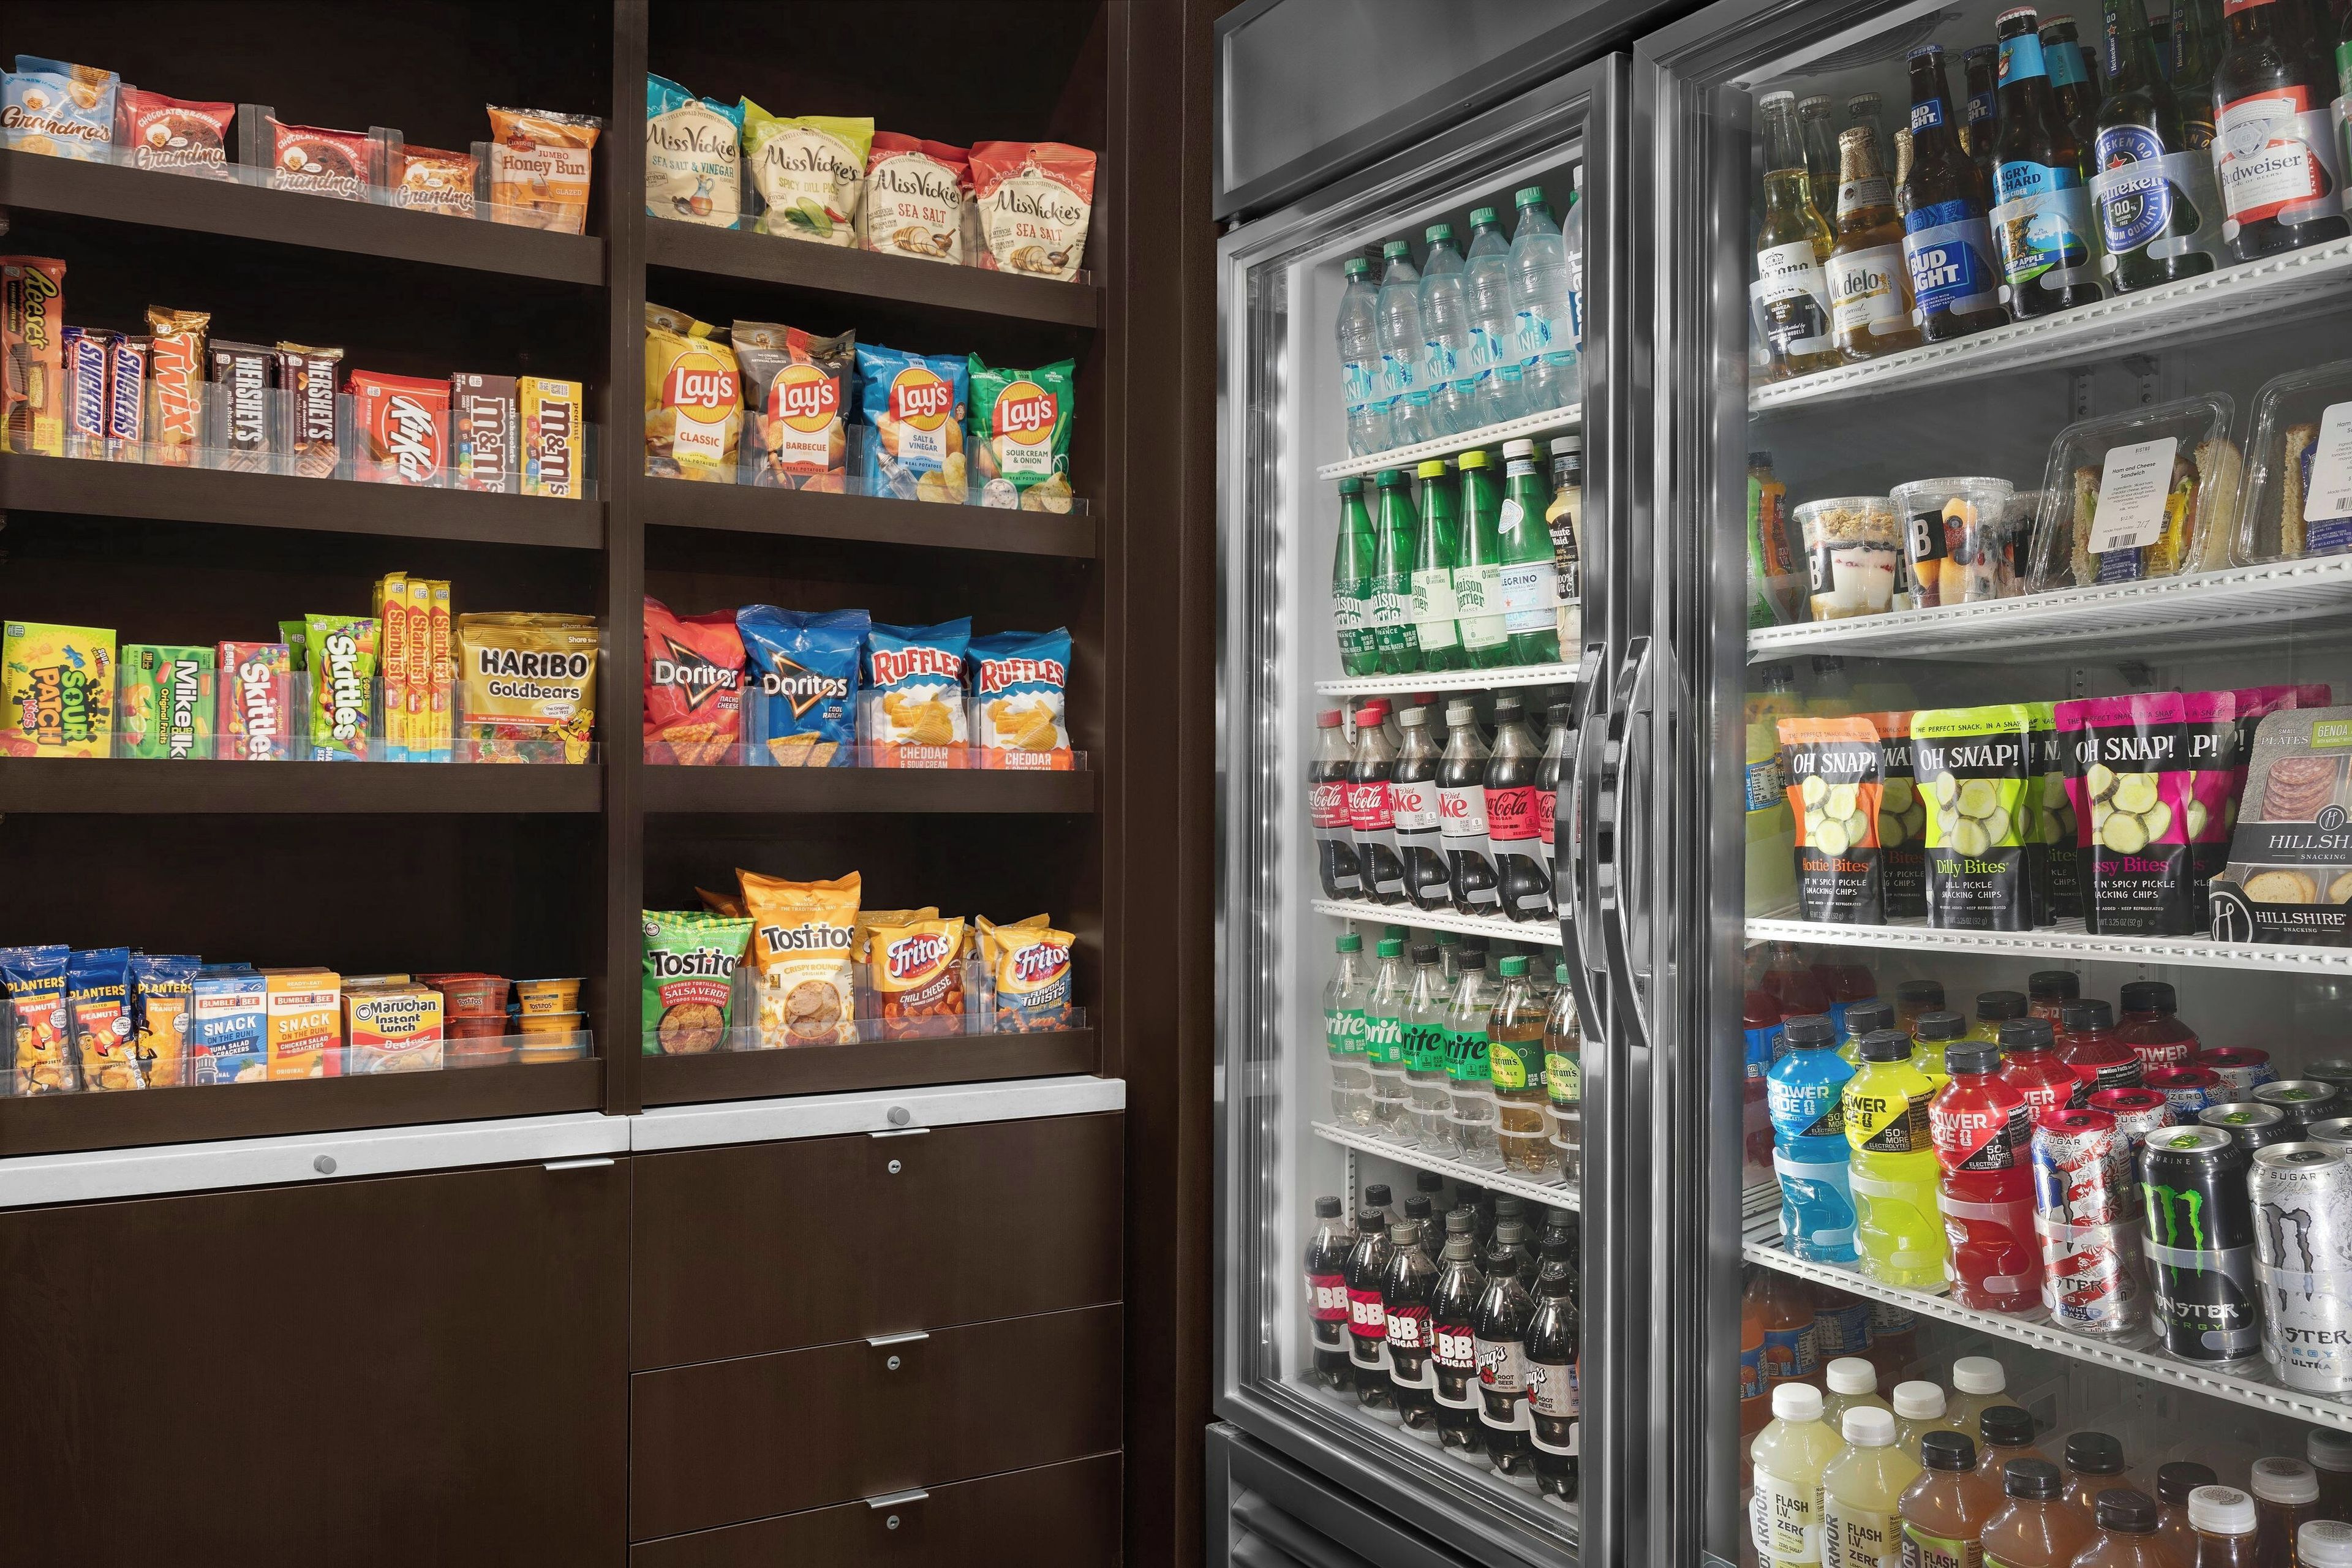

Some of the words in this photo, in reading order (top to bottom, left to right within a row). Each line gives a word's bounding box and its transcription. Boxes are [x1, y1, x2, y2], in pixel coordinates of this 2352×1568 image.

[1, 105, 111, 141] Grandma's
[538, 150, 568, 160] JUMBO
[503, 155, 551, 176] Honey
[556, 159, 585, 176] Bun
[652, 155, 668, 168] SEA
[670, 160, 688, 171] SALT
[692, 163, 699, 173] &
[701, 162, 734, 178] VINEGAR
[766, 144, 807, 173] Miss
[801, 145, 859, 186] Vickie's
[2222, 154, 2301, 187] Budweiser
[556, 187, 582, 196] GLAZED
[2010, 188, 2027, 197] CIDER
[898, 203, 918, 219] SEA
[923, 207, 946, 223] SALT
[994, 190, 1031, 214] Miss
[1027, 193, 1080, 225] Vickie's
[2116, 214, 2132, 222] ALCOHOL
[1017, 223, 1036, 239] SEA
[1041, 227, 1062, 241] SALT
[1911, 250, 1947, 274] BUD
[2019, 253, 2045, 265] APPLE
[23, 265, 59, 350] Reese's
[78, 341, 103, 434] SNICKERS
[115, 350, 140, 441] SNICKERS
[674, 367, 733, 408] Lay's
[236, 357, 263, 442] HERSHEY'S
[308, 360, 334, 440] HERSHEY'S
[778, 378, 835, 418] Lay's
[898, 382, 948, 418] Lay's
[1003, 394, 1052, 432] Lay's
[680, 432, 720, 447] CLASSIC
[786, 441, 827, 452] BARBECUE
[909, 442, 938, 452] VINEGAR
[1006, 450, 1025, 458] SOUR
[2120, 470, 2145, 479] Sandwich
[1915, 519, 1932, 557] B
[1810, 555, 1822, 590] B
[388, 610, 405, 680] Starburst
[410, 615, 428, 685] Starburst
[481, 649, 588, 677] HARIBO
[874, 649, 961, 685] RUFFLES
[655, 660, 738, 688] Doritos
[981, 659, 1065, 692] RUFFLES
[175, 660, 198, 728] Mike
[326, 635, 363, 740] Skittles
[489, 681, 580, 699] Goldbears
[763, 673, 848, 697] Doritos
[23, 698, 37, 728] Kids
[34, 668, 62, 745] PATCH
[61, 670, 86, 741] SOUR
[159, 688, 170, 720] Original
[159, 721, 169, 746] Fruits
[1928, 724, 1955, 733] PERFECT
[1958, 723, 1982, 731] SNACK,
[2318, 725, 2348, 737] GENOA
[2075, 739, 2100, 764] OH
[2105, 735, 2174, 761] SNAP!
[2261, 736, 2309, 746] PLATES
[900, 747, 948, 760] CHEDDAR
[1005, 753, 1051, 766] CHEDDAR
[1793, 754, 1815, 774] OH
[1820, 752, 1877, 774] SNAP!
[1920, 748, 1945, 771] OH
[1949, 744, 2018, 767] SNAP!
[1831, 858, 1869, 872] Bites
[1936, 859, 1962, 877] Dilly
[1965, 860, 2006, 873] Bites
[2123, 856, 2169, 872] Bites
[1945, 881, 1959, 889] DILL
[1962, 881, 1992, 889] PICKLE
[2112, 880, 2138, 890] SPICY
[2133, 890, 2159, 899] CHIPS
[2256, 911, 2346, 925] HILLSHIRE
[887, 934, 949, 978] Fritos
[1015, 943, 1069, 981] Fritos
[784, 964, 810, 975] CRISPY
[7, 976, 65, 993] PLANTERS
[665, 981, 692, 990] FLAVORED
[665, 987, 697, 999] SALSA
[698, 987, 728, 1000] VERDE
[922, 975, 952, 999] CHEESE
[20, 1001, 56, 1012] PEANUTS
[203, 998, 233, 1008] BUMBLE
[278, 996, 309, 1005] BUMBLE
[371, 1000, 436, 1013] Maruchan
[204, 1016, 256, 1037] SNACK
[279, 1012, 330, 1034] SNACK
[375, 1014, 421, 1023] Instant
[380, 1023, 416, 1032] Lunch
[228, 1040, 249, 1049] SALAD
[281, 1039, 307, 1050] CHICKEN
[308, 1036, 329, 1046] SALAD
[385, 1038, 410, 1049] Beef
[2170, 1092, 2202, 1101] ZERO
[2286, 1104, 2340, 1117] VITAMINS
[2271, 1170, 2316, 1182] SUGAR
[2063, 1311, 2087, 1321] RAZZ
[1442, 1357, 1474, 1368] SUGAR
[1475, 1346, 1507, 1375] Barq's
[1776, 1494, 1809, 1513] FLASH
[1847, 1522, 1882, 1543] FLASH
